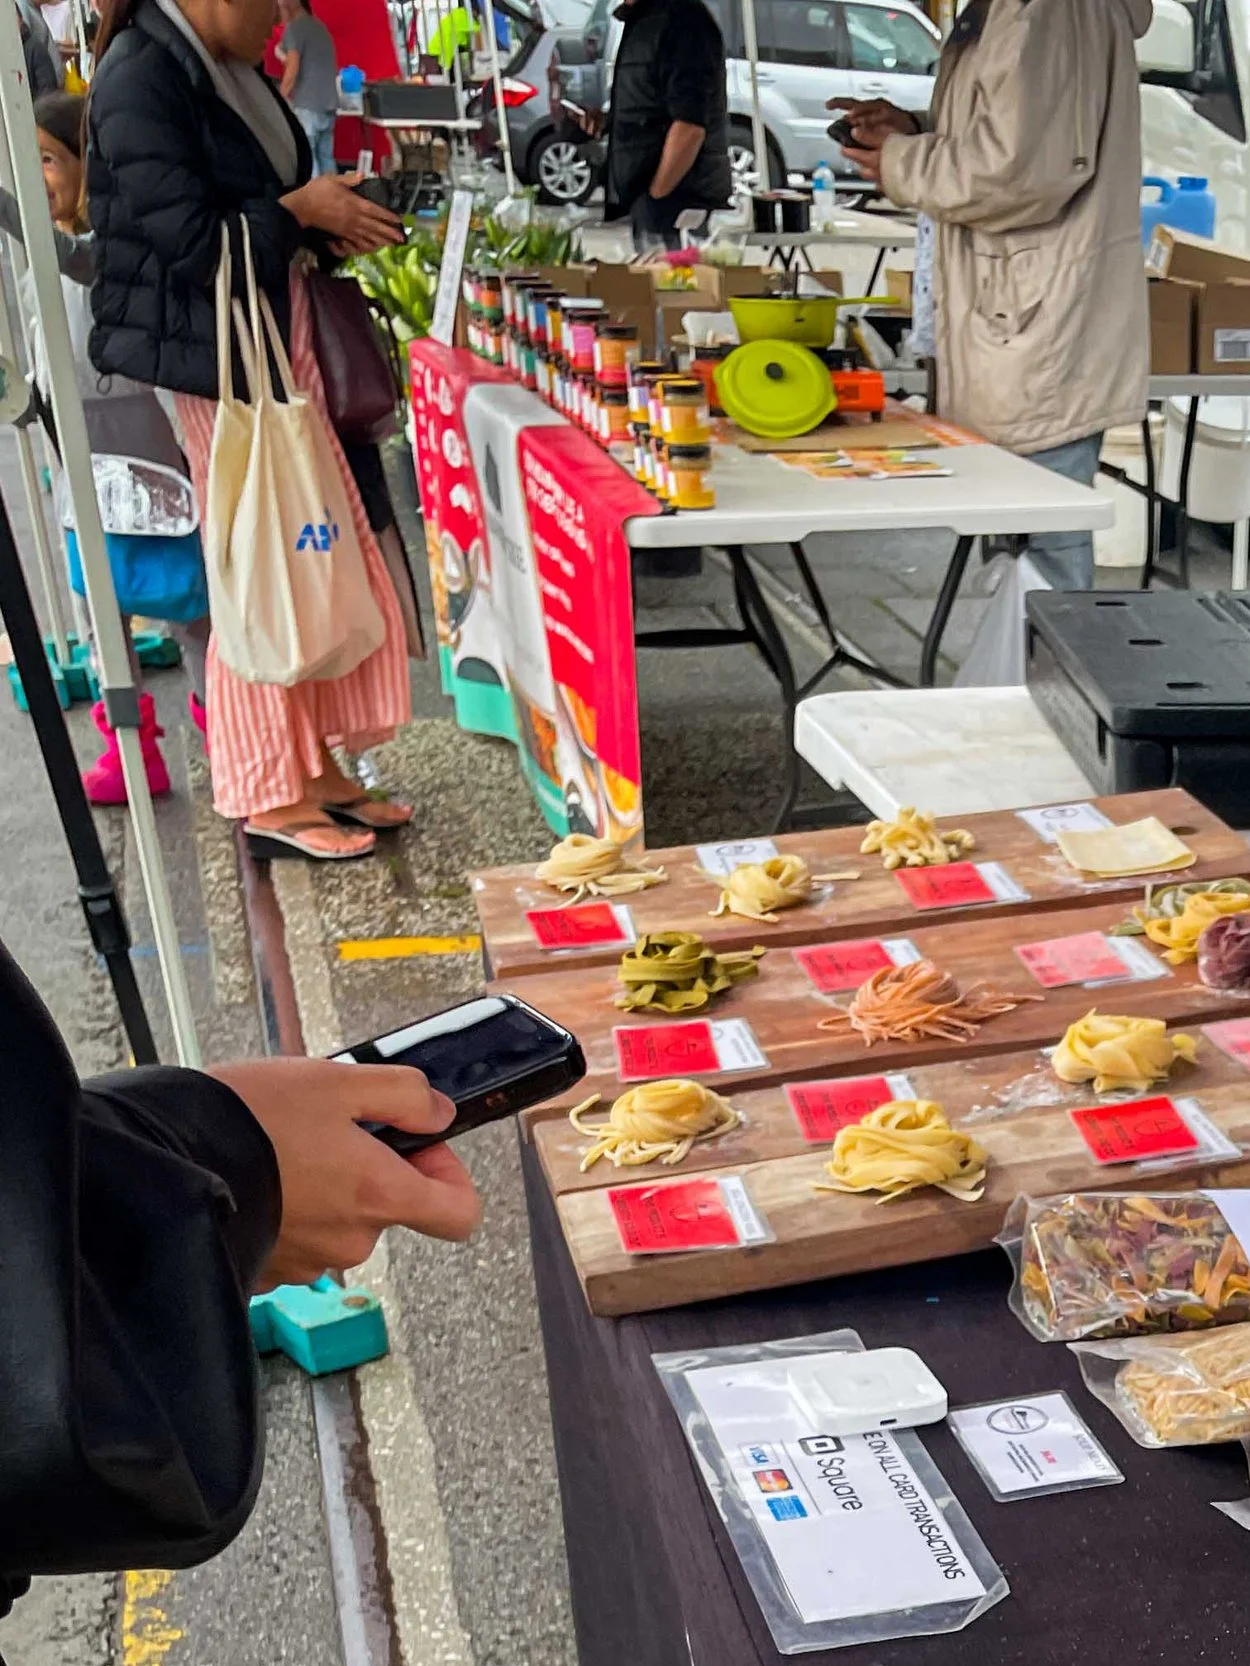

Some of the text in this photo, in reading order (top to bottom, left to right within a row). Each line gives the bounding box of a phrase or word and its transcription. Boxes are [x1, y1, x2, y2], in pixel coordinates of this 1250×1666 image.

[865, 1438, 893, 1457] ON
[874, 1454, 904, 1474] ALL
[808, 1455, 872, 1513] Square
[886, 1472, 920, 1501] CARD
[900, 1499, 968, 1580] TRANSACTIONS
